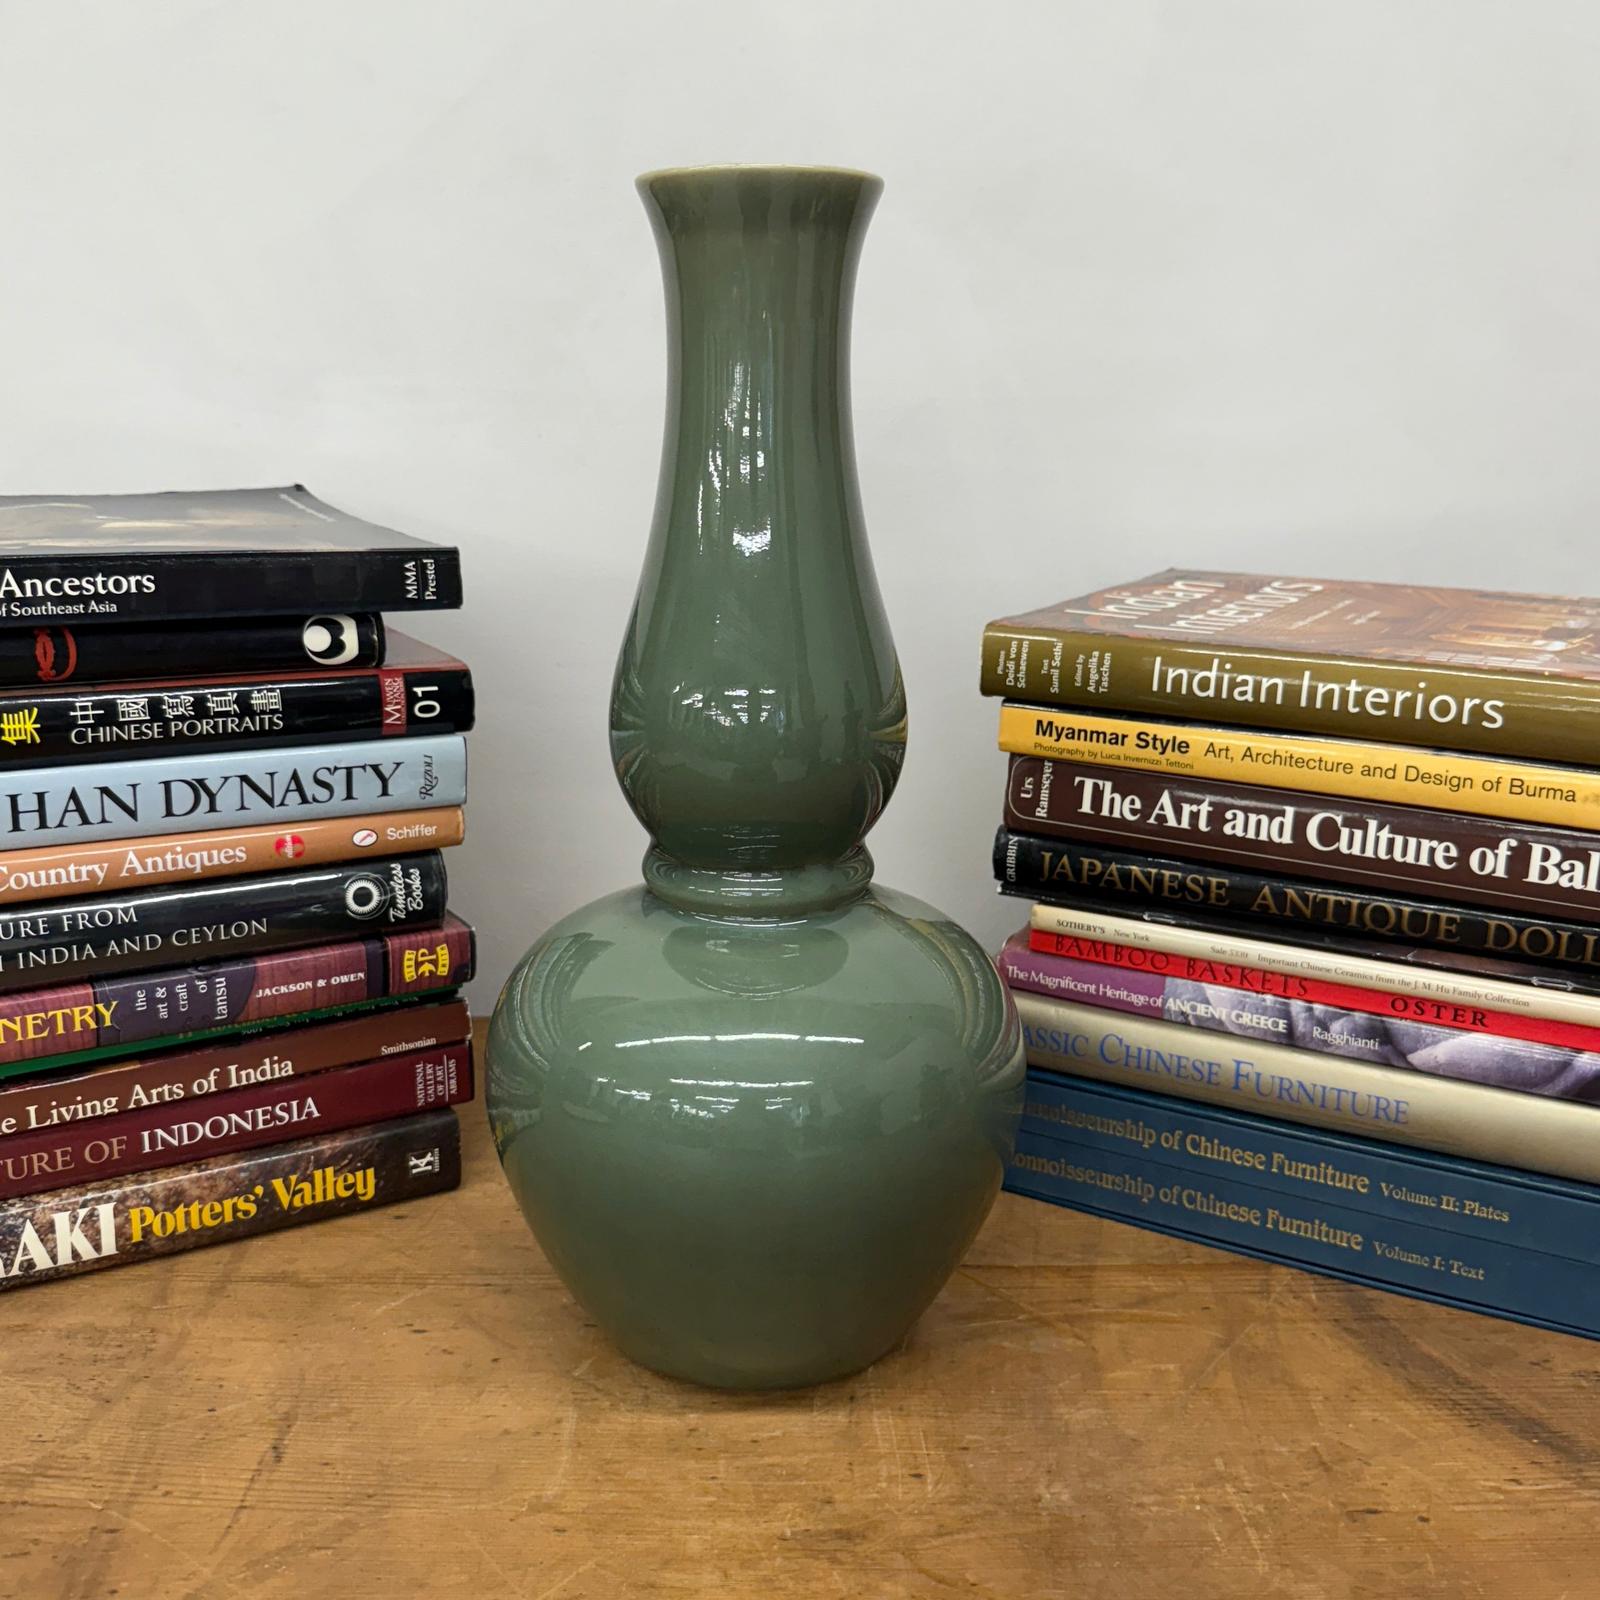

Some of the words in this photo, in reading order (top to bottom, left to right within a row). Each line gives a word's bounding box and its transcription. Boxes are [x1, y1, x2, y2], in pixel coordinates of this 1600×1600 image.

[0, 568, 156, 599] Ancestors
[404, 561, 418, 599] MMA
[422, 558, 437, 600] Prestel
[1064, 579, 1225, 619] Indian
[10, 601, 85, 617] Southeast
[88, 600, 118, 614] Asia
[1009, 641, 1018, 659] von
[1017, 640, 1029, 688] Schaewen
[1051, 641, 1063, 667] Sethi
[1006, 660, 1016, 686] Deidi
[1050, 668, 1059, 694] Sunil
[1087, 651, 1100, 693] Angelika
[1098, 652, 1111, 693] Taschen
[412, 685, 441, 719] 01
[1151, 656, 1284, 705] Indian
[1299, 670, 1505, 730] Interiors
[0, 707, 41, 746] 集
[71, 722, 164, 745] CHINESE
[171, 714, 284, 738] PORTRAITS
[1034, 742, 1085, 758] Photography
[1087, 749, 1098, 759] by
[1100, 751, 1121, 761] Luca
[1123, 753, 1162, 766] Invernizzi
[1165, 758, 1194, 770] Tettoni
[1035, 719, 1129, 747] Myanmar
[1135, 731, 1190, 755] Style
[1203, 741, 1234, 763] Art,
[1241, 746, 1354, 775] Architecture
[1360, 763, 1397, 780] and
[1404, 765, 1474, 793] Design
[1481, 776, 1503, 793] of
[1509, 778, 1577, 803] Burma
[5, 783, 142, 833] HAN
[158, 761, 404, 819] DYNASTY
[1020, 776, 1034, 799] Urs
[1035, 760, 1053, 818] Ramseyer
[386, 823, 438, 841] Schiffer
[1073, 775, 1142, 821] The
[1146, 788, 1213, 832] Art
[1222, 806, 1295, 845] and
[1305, 811, 1458, 870] Culture
[1469, 839, 1517, 879] of
[120, 845, 247, 877] Antiques
[1006, 835, 1019, 882] GRIBBIN
[388, 863, 407, 922] Timeless
[406, 868, 424, 911] Books
[1039, 851, 1230, 907] JAPANESE
[1250, 885, 1461, 942] ANTIQUE
[62, 907, 138, 932] FROM
[18, 942, 97, 970] INDIA
[106, 933, 163, 957] AND
[172, 918, 268, 946] CEYLON
[1056, 918, 1106, 935] SOTHEBY'S
[1113, 927, 1130, 939] New
[1132, 930, 1151, 943] York
[1257, 953, 1299, 969] Important
[1300, 960, 1334, 975] Chinese
[1334, 967, 1374, 982] Ceramics
[1375, 974, 1397, 985] from
[1397, 978, 1412, 988] the
[1435, 984, 1450, 995] Hu
[1452, 986, 1483, 1001] Family
[1484, 992, 1530, 1007] Collection
[255, 981, 313, 998] JACKSON
[317, 979, 327, 988] &
[330, 972, 365, 984] OWEN
[1055, 935, 1169, 971] BAMBOO
[1186, 960, 1309, 997] BASKETS
[135, 989, 147, 1011] the
[156, 987, 167, 999] &
[175, 982, 188, 1012] craft
[194, 980, 207, 993] of
[213, 976, 228, 1021] tansu
[1006, 965, 1029, 982] The
[1030, 970, 1097, 995] Magnificent
[1099, 983, 1149, 1007] Heritage
[1150, 994, 1164, 1007] of
[1165, 997, 1230, 1020] ANCIENT
[1230, 1009, 1288, 1033] GREECE
[0, 1001, 119, 1044] NETRY
[158, 1004, 168, 1019] art
[1390, 997, 1489, 1028] OSTER
[381, 1036, 437, 1056] Smithsonian
[1312, 1026, 1379, 1050] Ragghianti
[26, 1095, 119, 1130] Living
[129, 1084, 185, 1109] Arts
[193, 1068, 221, 1095] of
[228, 1056, 294, 1087] India
[415, 1060, 425, 1107] NATIONAL
[425, 1062, 435, 1102] GALLERY
[435, 1065, 444, 1083] ART
[436, 1084, 444, 1096] OF
[1098, 1033, 1222, 1087] CHINESE
[1231, 1058, 1410, 1125] FURNITURE
[84, 1136, 128, 1164] OF
[141, 1096, 321, 1153] INDONESIA
[1160, 1130, 1183, 1150] of
[1185, 1134, 1266, 1170] Chinese
[1271, 1152, 1370, 1193] Furniture
[1379, 1182, 1437, 1207] Volume
[1440, 1195, 1460, 1212] II:
[1462, 1200, 1511, 1222] Plates
[0, 1202, 118, 1278] AKI
[271, 1166, 376, 1211] Valley
[1159, 1185, 1182, 1206] of
[1182, 1188, 1261, 1226] Chinese
[1266, 1207, 1364, 1251] Furniture
[1372, 1240, 1430, 1268] Volume
[1449, 1259, 1486, 1281] Text
